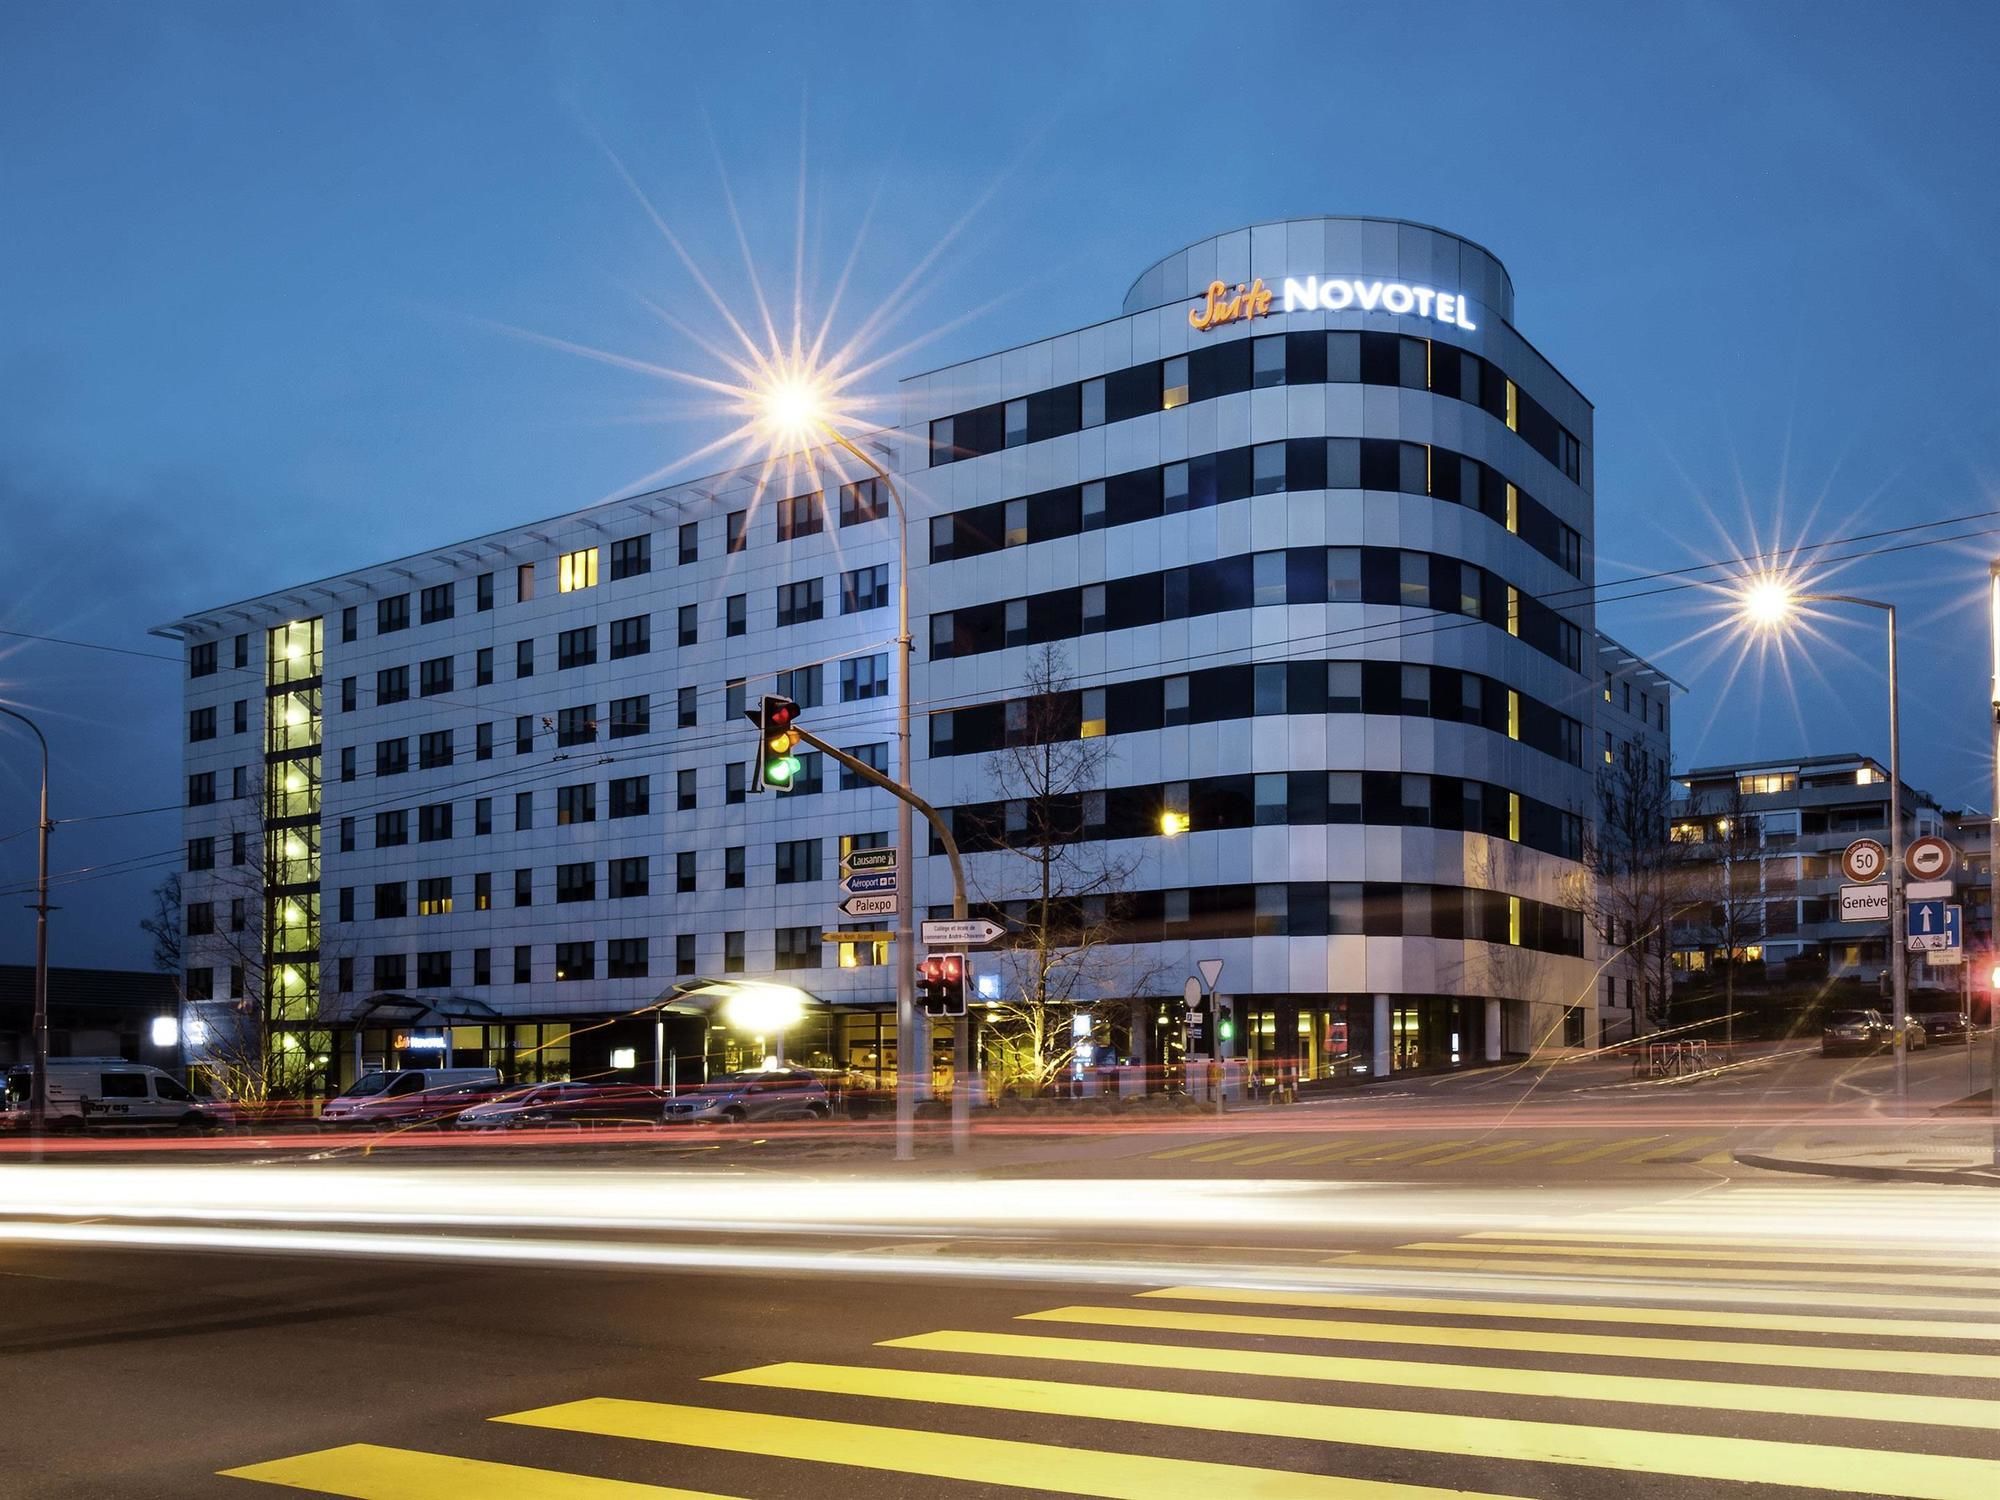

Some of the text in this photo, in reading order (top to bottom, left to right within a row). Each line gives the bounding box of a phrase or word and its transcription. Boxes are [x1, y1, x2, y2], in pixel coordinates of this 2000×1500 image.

[1189, 276, 1476, 331] Suite NOVOTEL
[853, 855, 887, 866] Lausanne
[1856, 854, 1873, 868] 50
[851, 878, 879, 888] Aéroport
[856, 899, 892, 913] Palexpo
[1842, 895, 1887, 908] Genève
